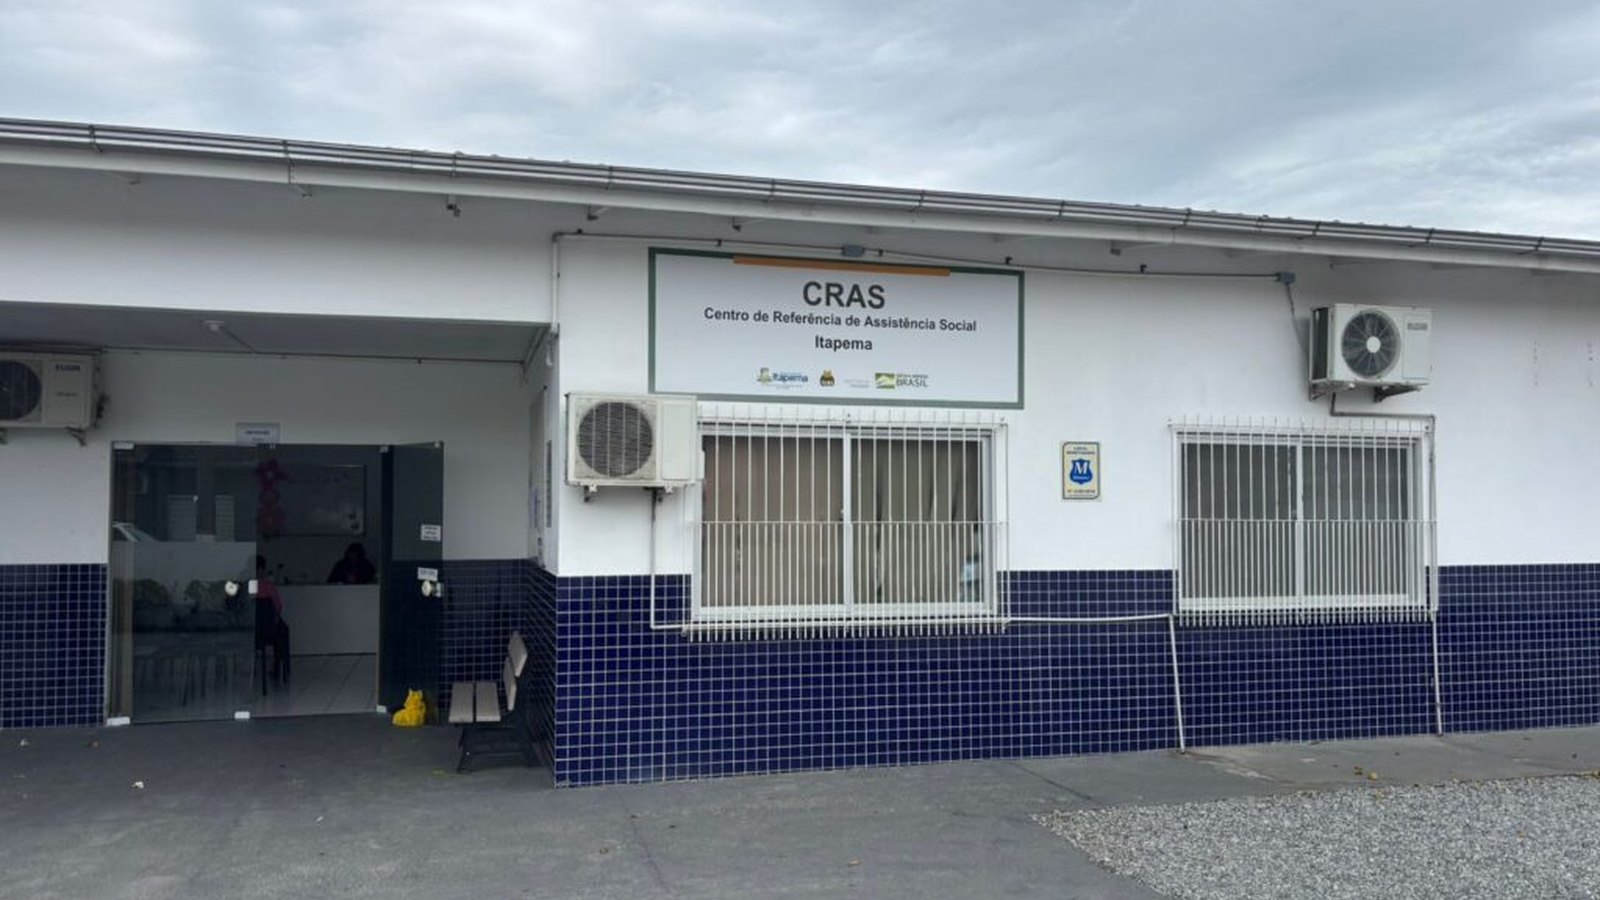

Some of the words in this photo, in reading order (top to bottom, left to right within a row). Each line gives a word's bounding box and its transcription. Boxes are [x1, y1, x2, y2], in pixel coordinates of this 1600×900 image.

[803, 280, 886, 309] CRAS
[704, 307, 749, 321] Centro
[753, 310, 769, 322] de
[773, 311, 842, 326] Referência
[845, 314, 861, 326] de
[864, 315, 936, 330] Assistência
[939, 319, 977, 332] Social
[815, 335, 873, 351] Itapema
[896, 378, 927, 388] BRASIL
[1073, 461, 1089, 475] M
